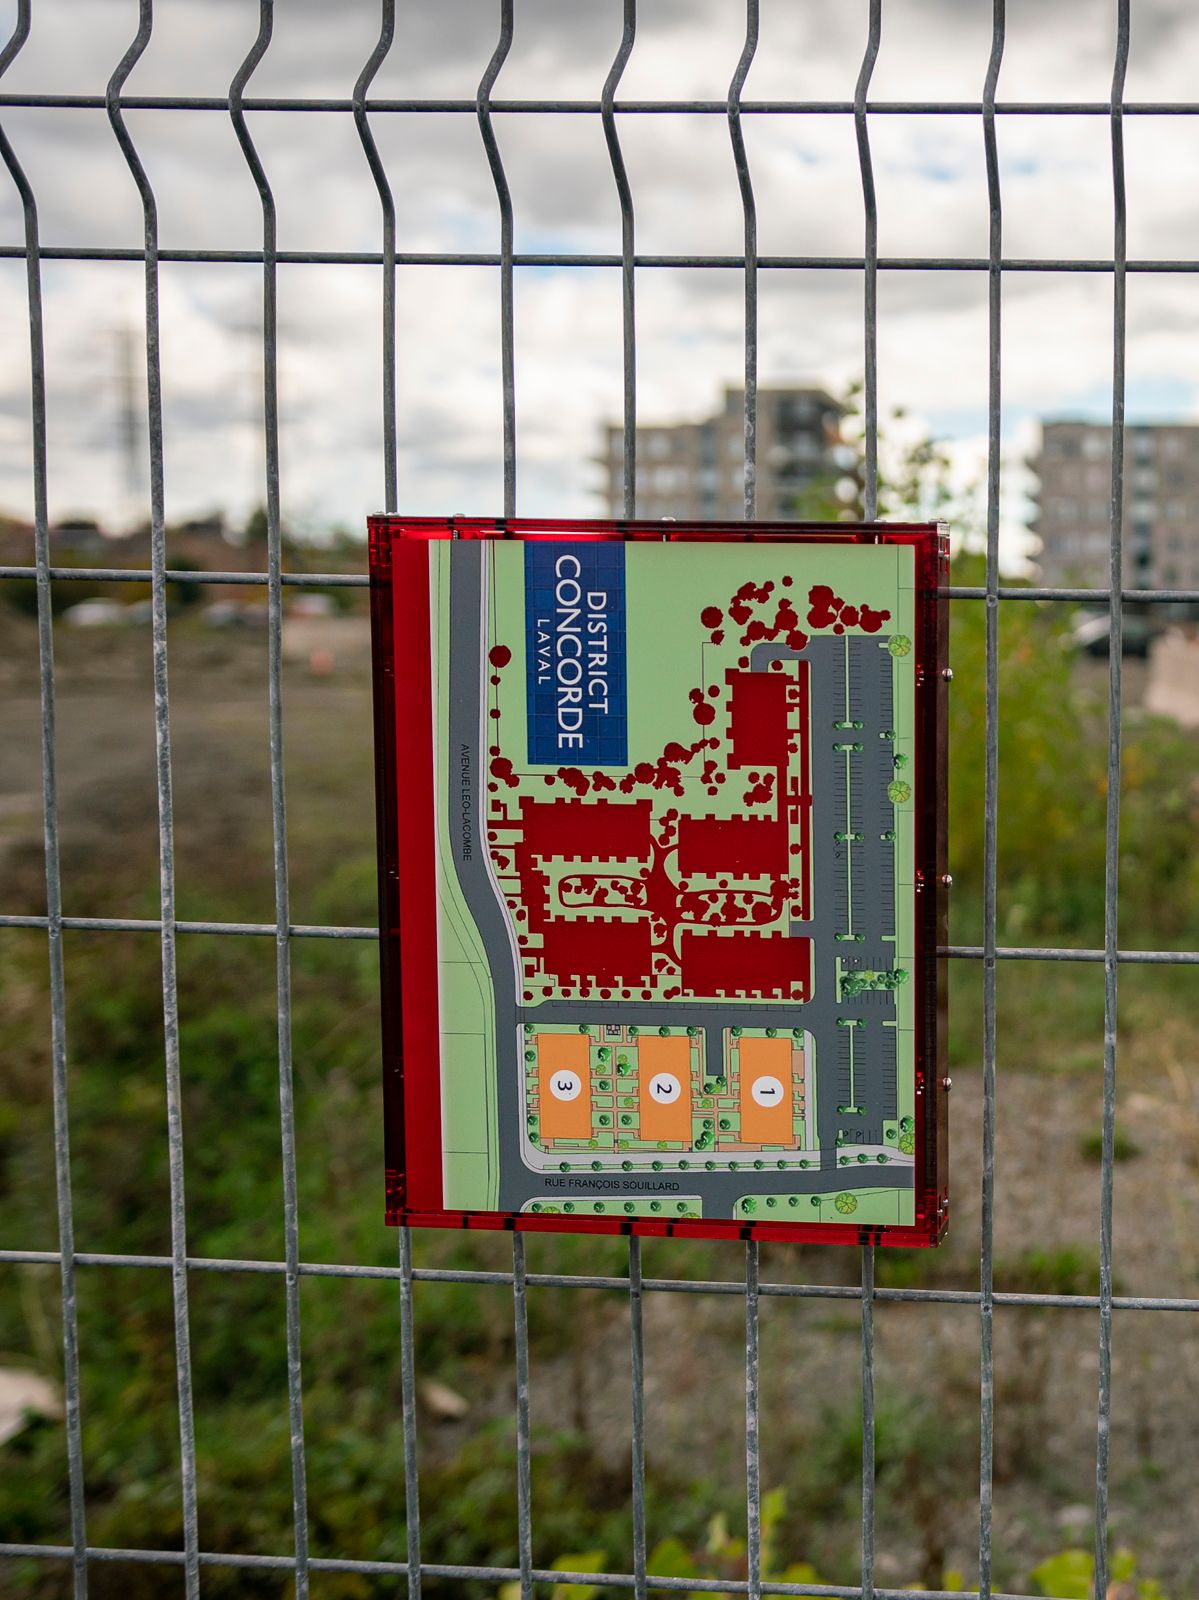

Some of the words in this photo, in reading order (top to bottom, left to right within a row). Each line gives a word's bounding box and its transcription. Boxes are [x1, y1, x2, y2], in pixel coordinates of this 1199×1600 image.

[537, 619, 551, 685] LAVAL
[555, 554, 584, 749] CONCORDE
[587, 592, 608, 714] DISTRICT
[461, 743, 471, 786] AVENUE
[557, 1080, 573, 1091] 3
[656, 1083, 672, 1094] 2
[760, 1087, 776, 1095] 1
[544, 1178, 566, 1187] RUE
[568, 1179, 620, 1190] FRANÇOIS
[622, 1180, 680, 1191] SOUILLARD
